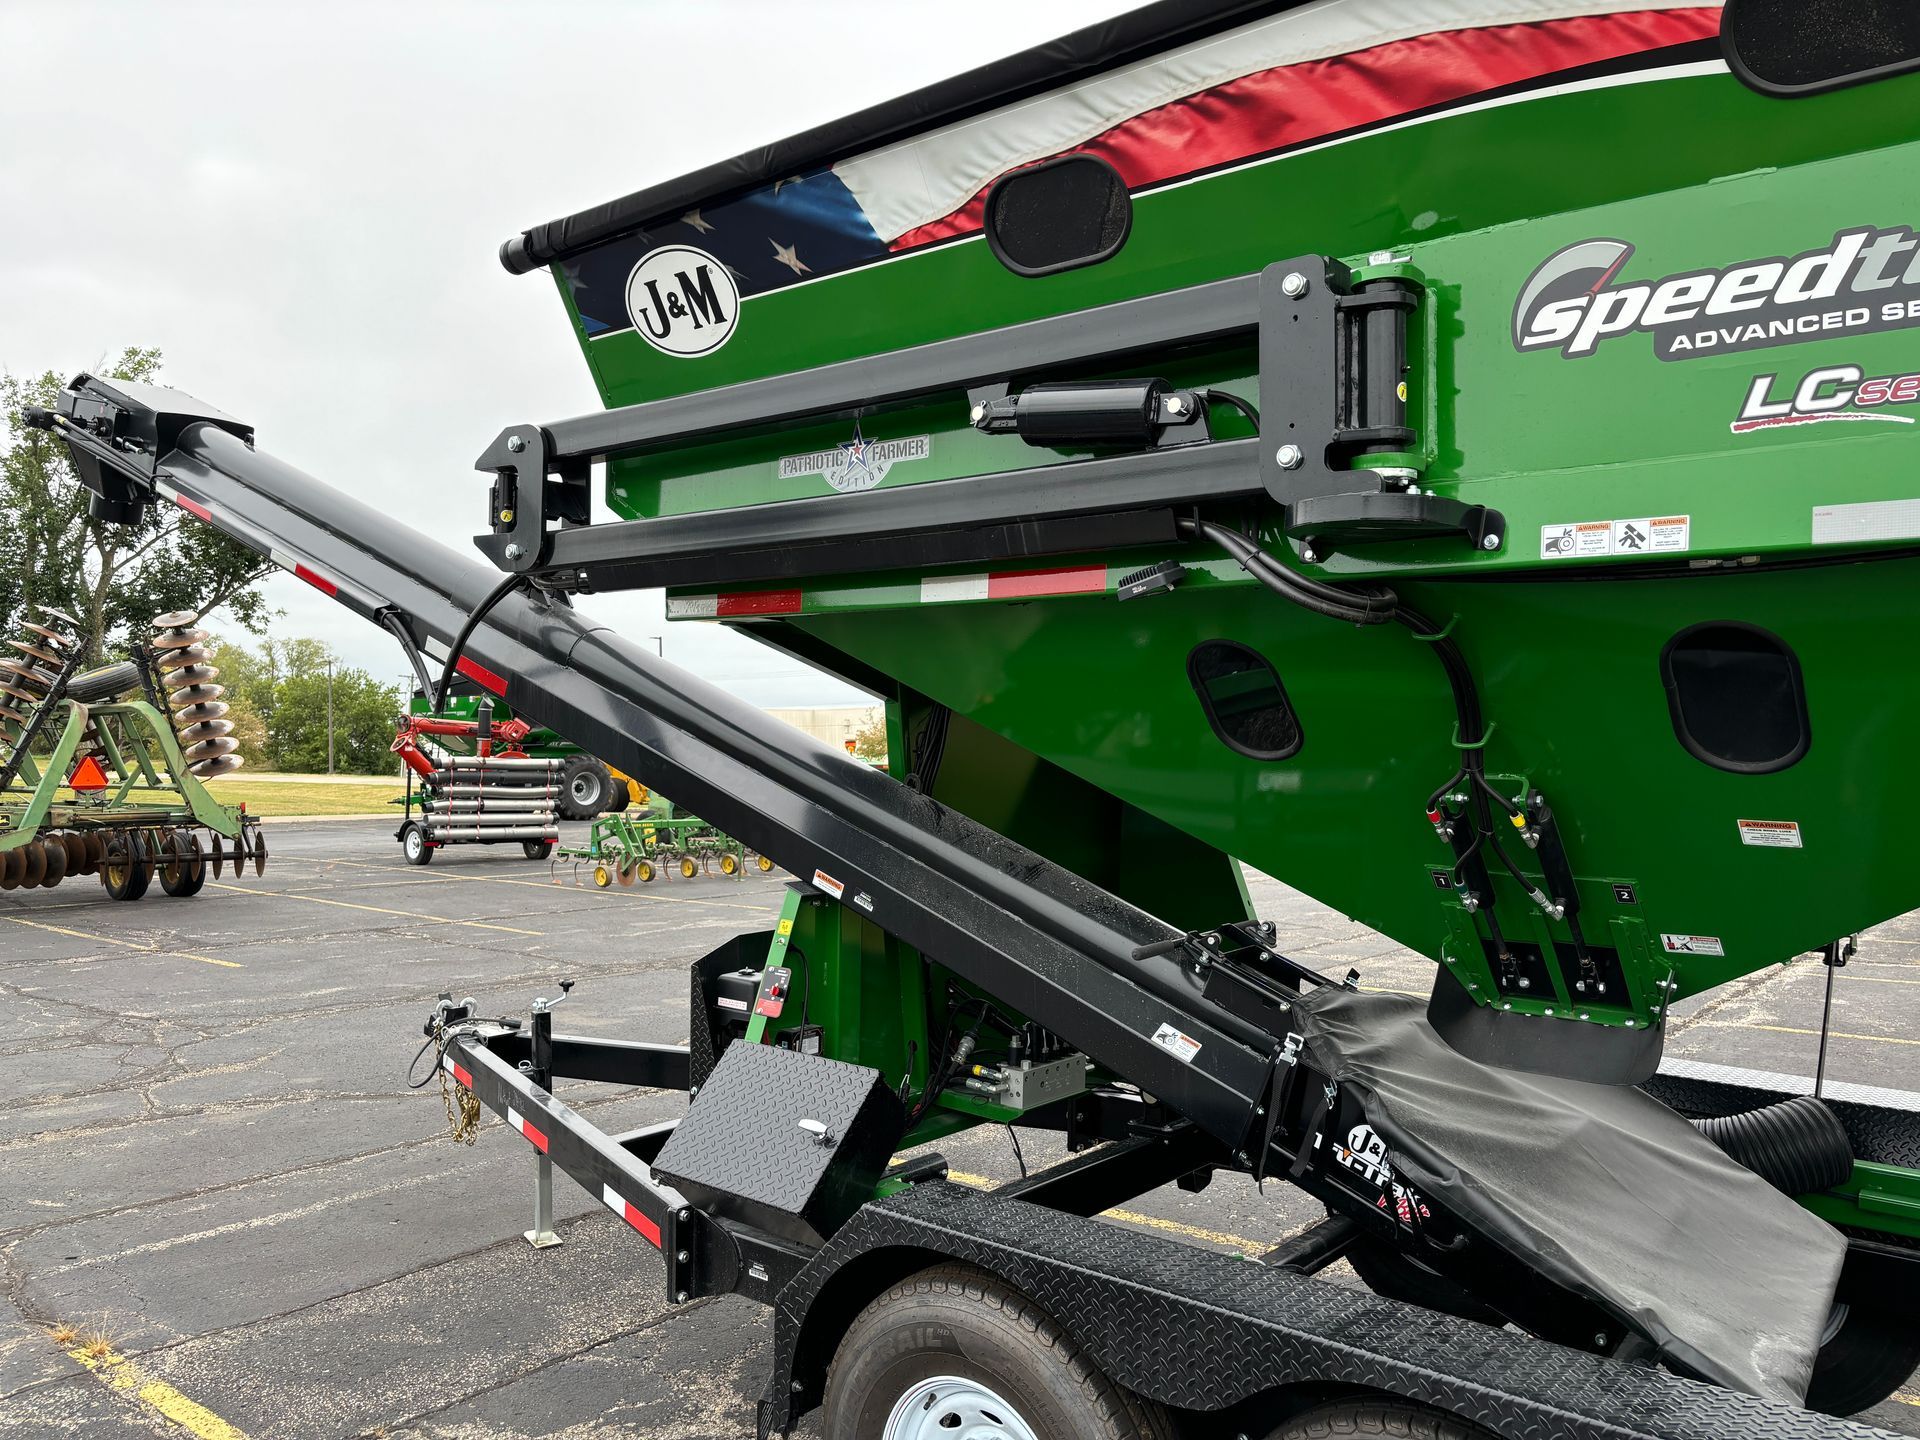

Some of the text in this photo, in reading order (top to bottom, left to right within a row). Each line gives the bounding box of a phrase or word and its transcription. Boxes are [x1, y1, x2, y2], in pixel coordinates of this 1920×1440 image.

[639, 264, 728, 339] J&M
[1669, 307, 1870, 352] ADVANCED
[783, 439, 925, 475] PATRIOTIC FARMER
[830, 464, 884, 487] EDITION
[1582, 523, 1609, 531] WARNING
[1657, 518, 1686, 526] WARNING
[1620, 891, 1630, 899] 2
